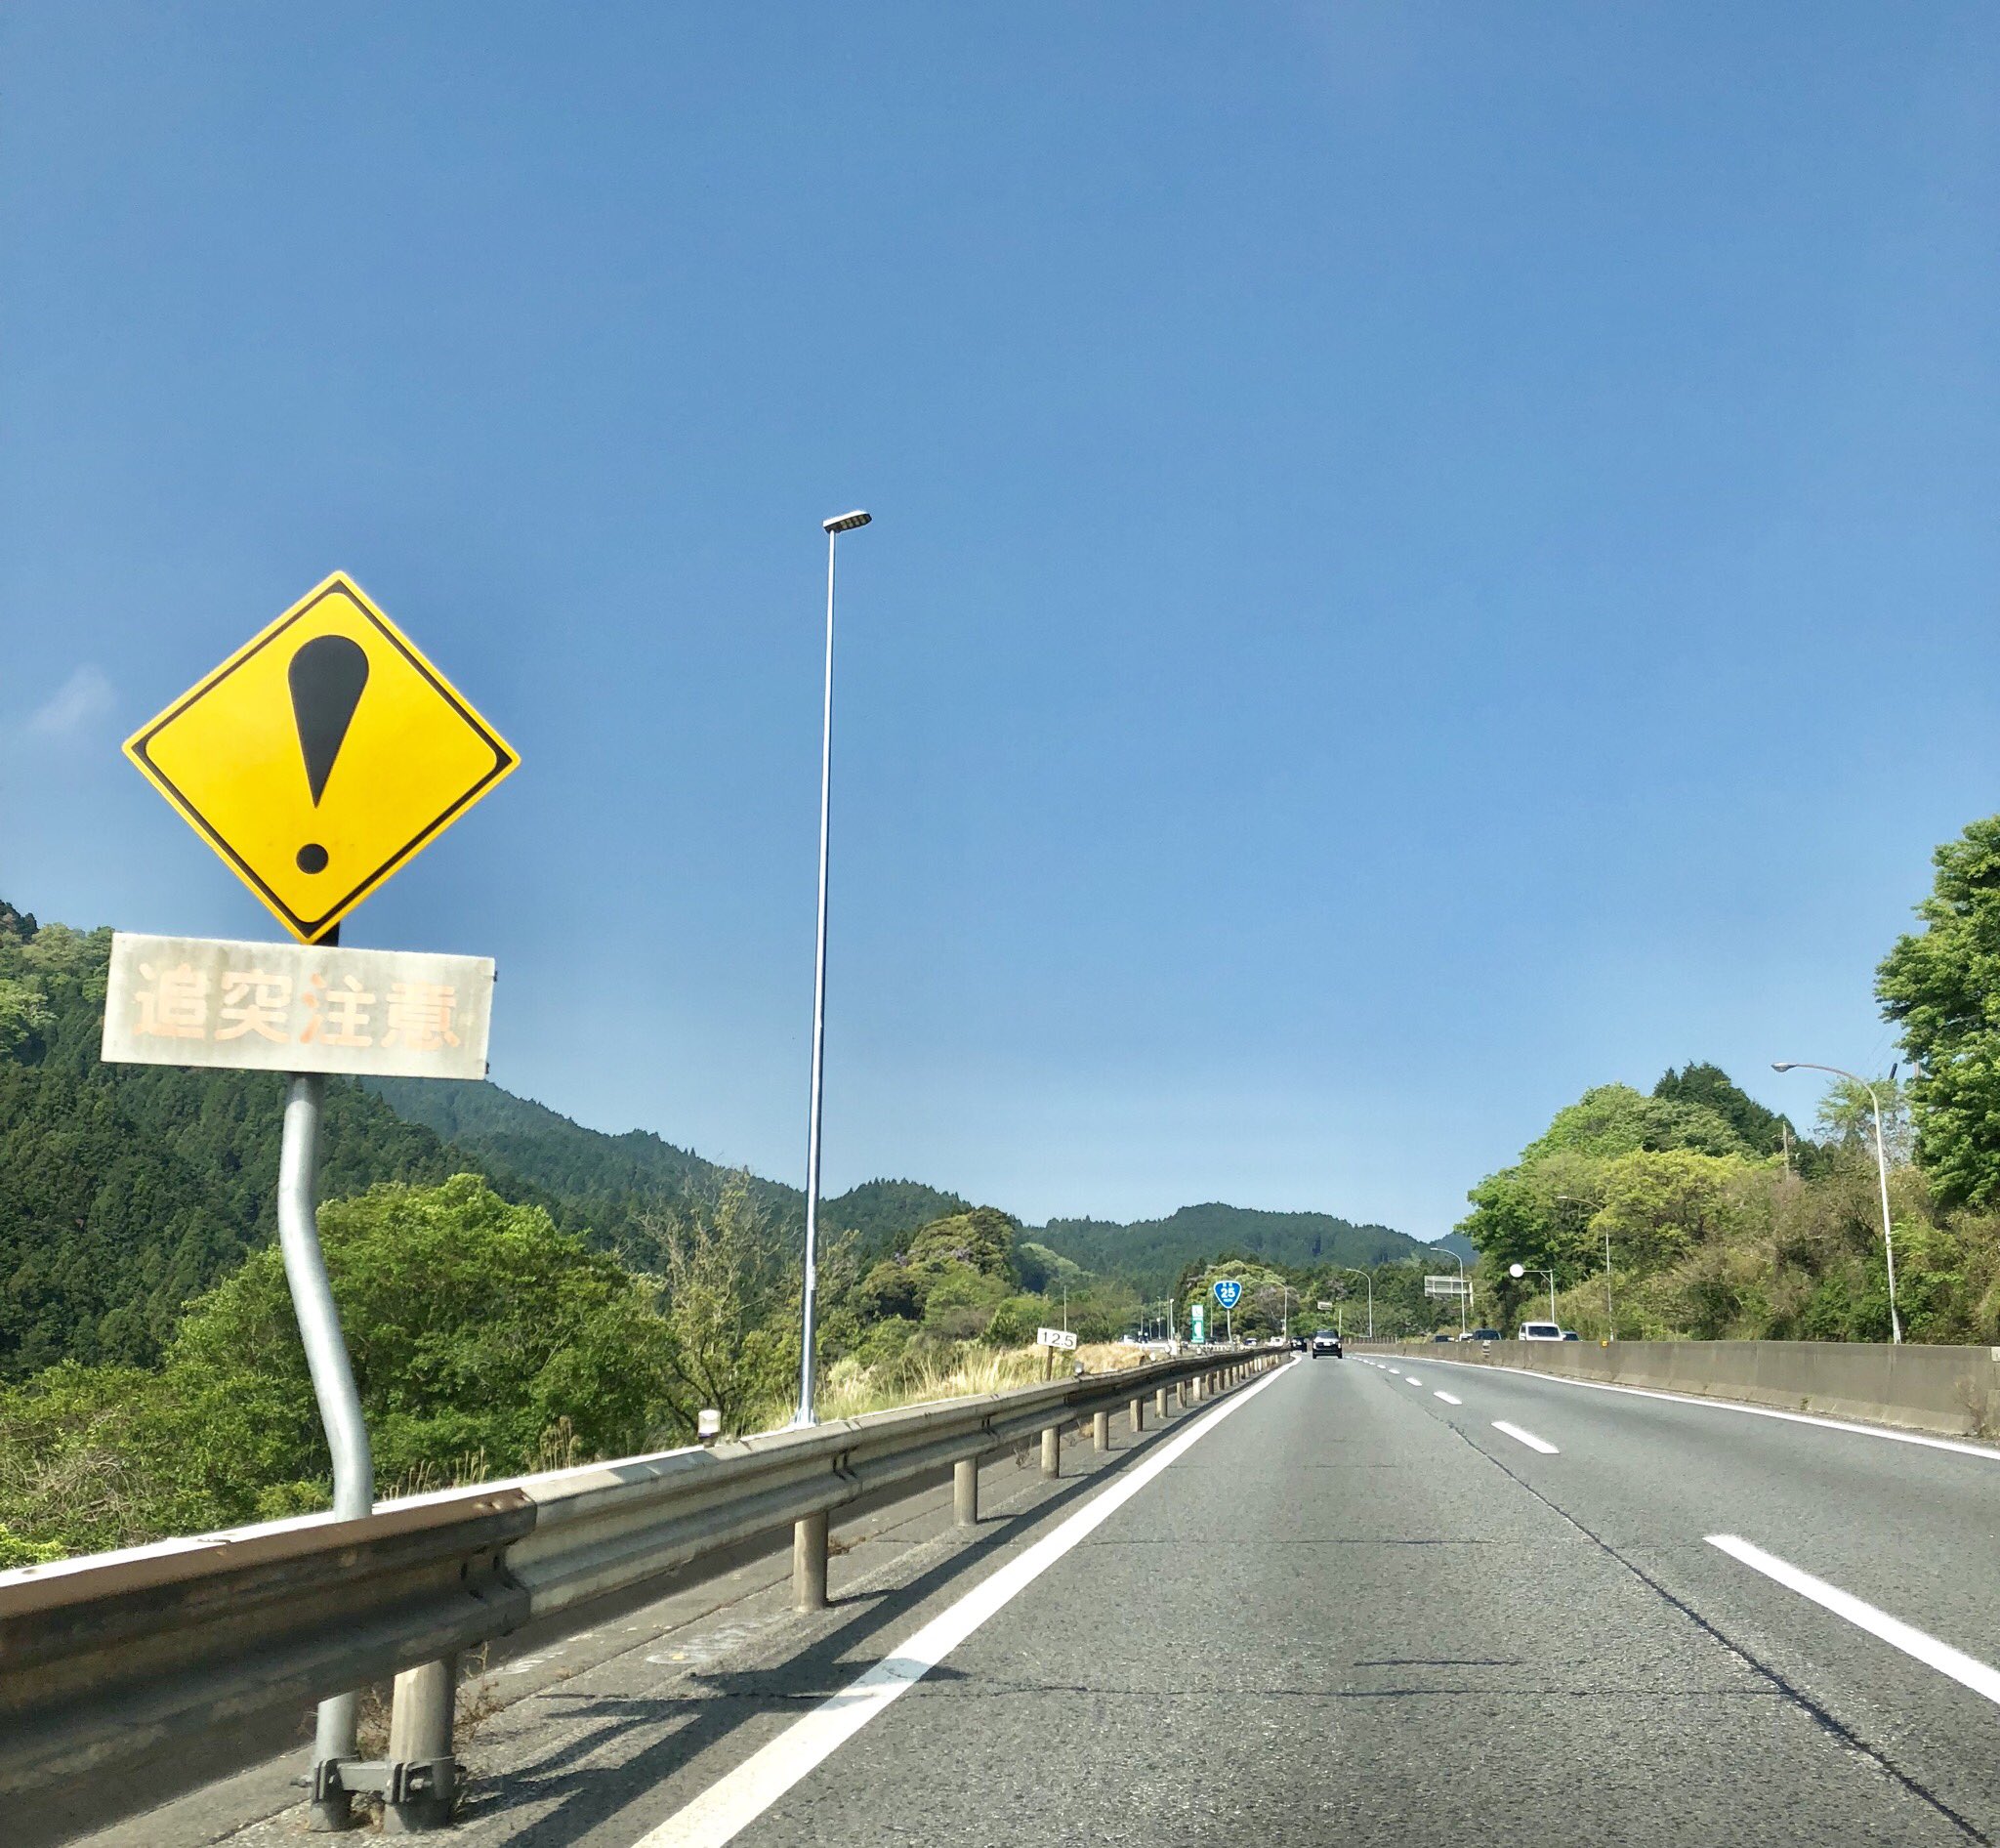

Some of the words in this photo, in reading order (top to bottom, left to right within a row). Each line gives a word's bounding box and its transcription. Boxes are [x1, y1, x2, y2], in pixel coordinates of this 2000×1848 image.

[132, 962, 462, 1052] 追突注意
[1221, 1287, 1235, 1298] 25
[1044, 1331, 1073, 1347] 12.5
